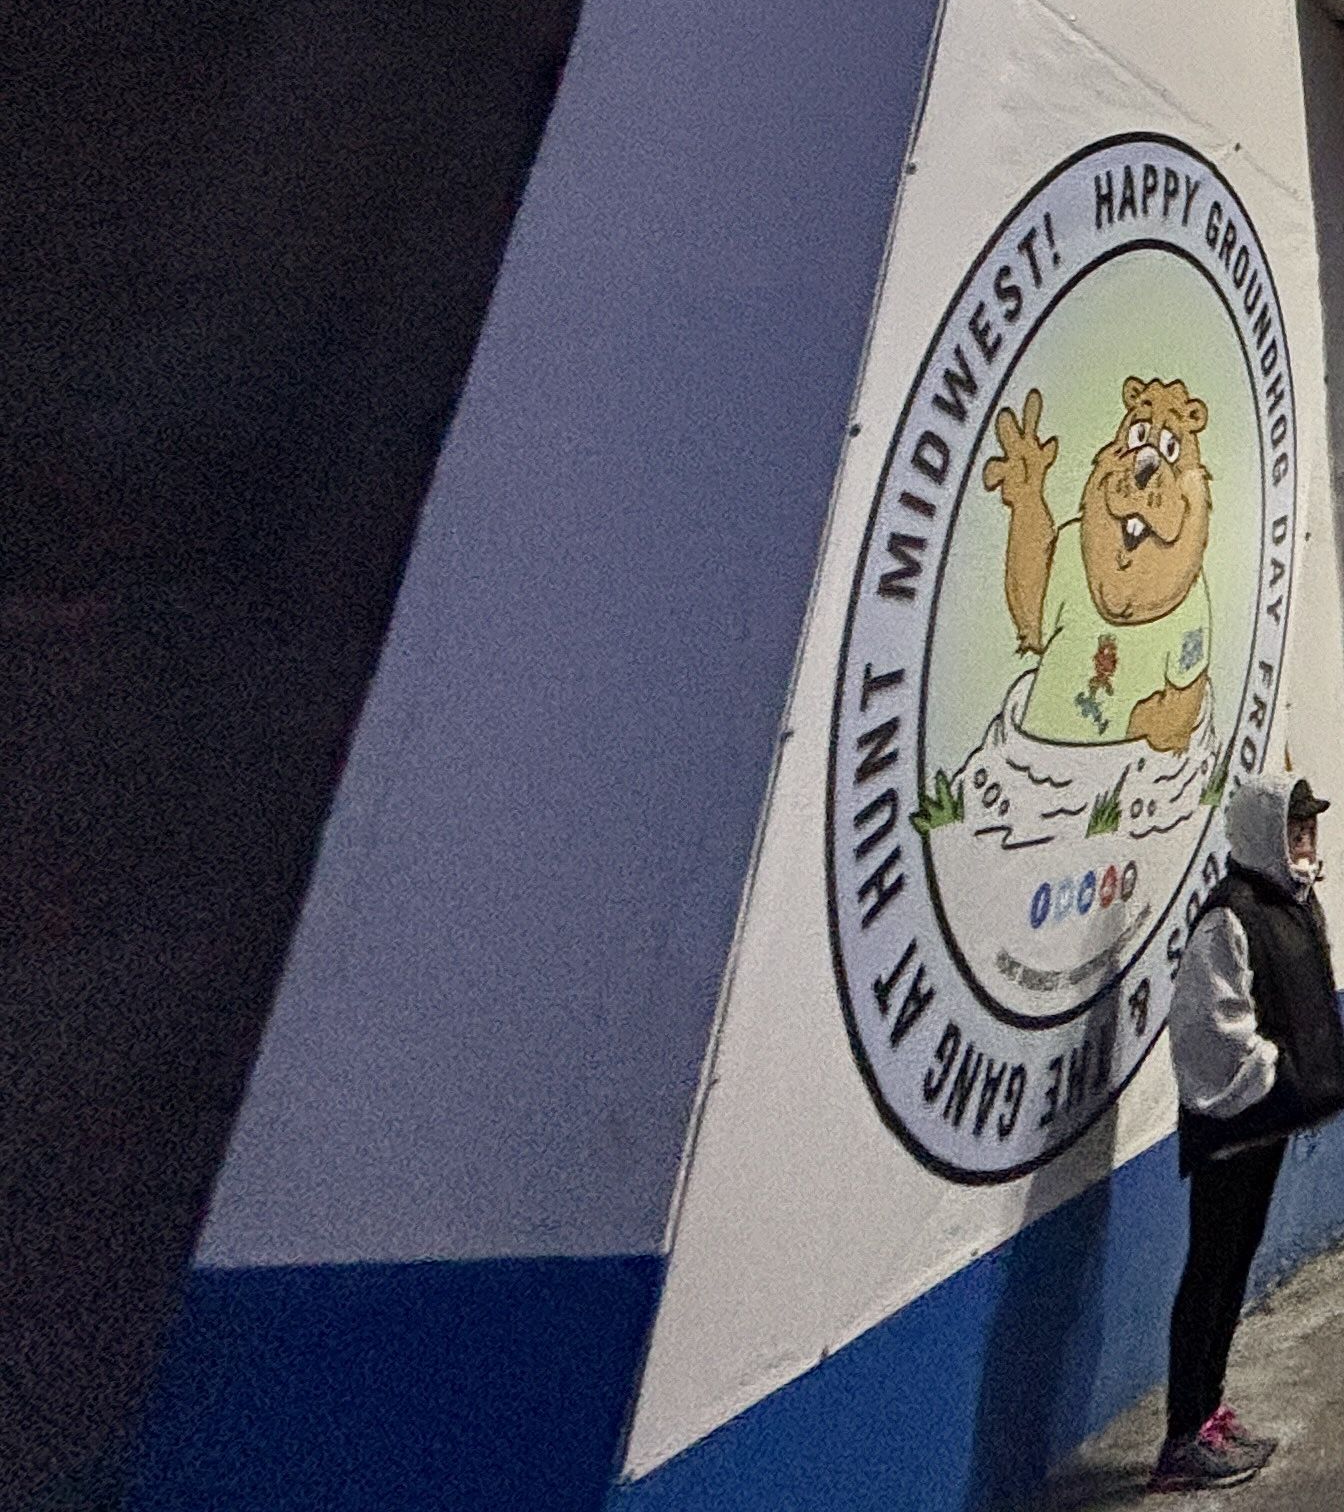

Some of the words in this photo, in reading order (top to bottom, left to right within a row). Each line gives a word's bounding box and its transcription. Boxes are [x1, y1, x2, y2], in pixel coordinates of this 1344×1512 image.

[1094, 162, 1201, 230] HAPPY
[1204, 200, 1290, 488] GROUNDHOG
[877, 212, 1062, 604] MIDWEST!
[1265, 514, 1289, 628] DAY
[1233, 659, 1273, 792] FRO
[853, 662, 907, 929] HUNT
[872, 938, 935, 1049] AT
[1128, 977, 1151, 1038] &
[922, 1020, 1027, 1143] GANG
[1039, 1027, 1113, 1129] THE
